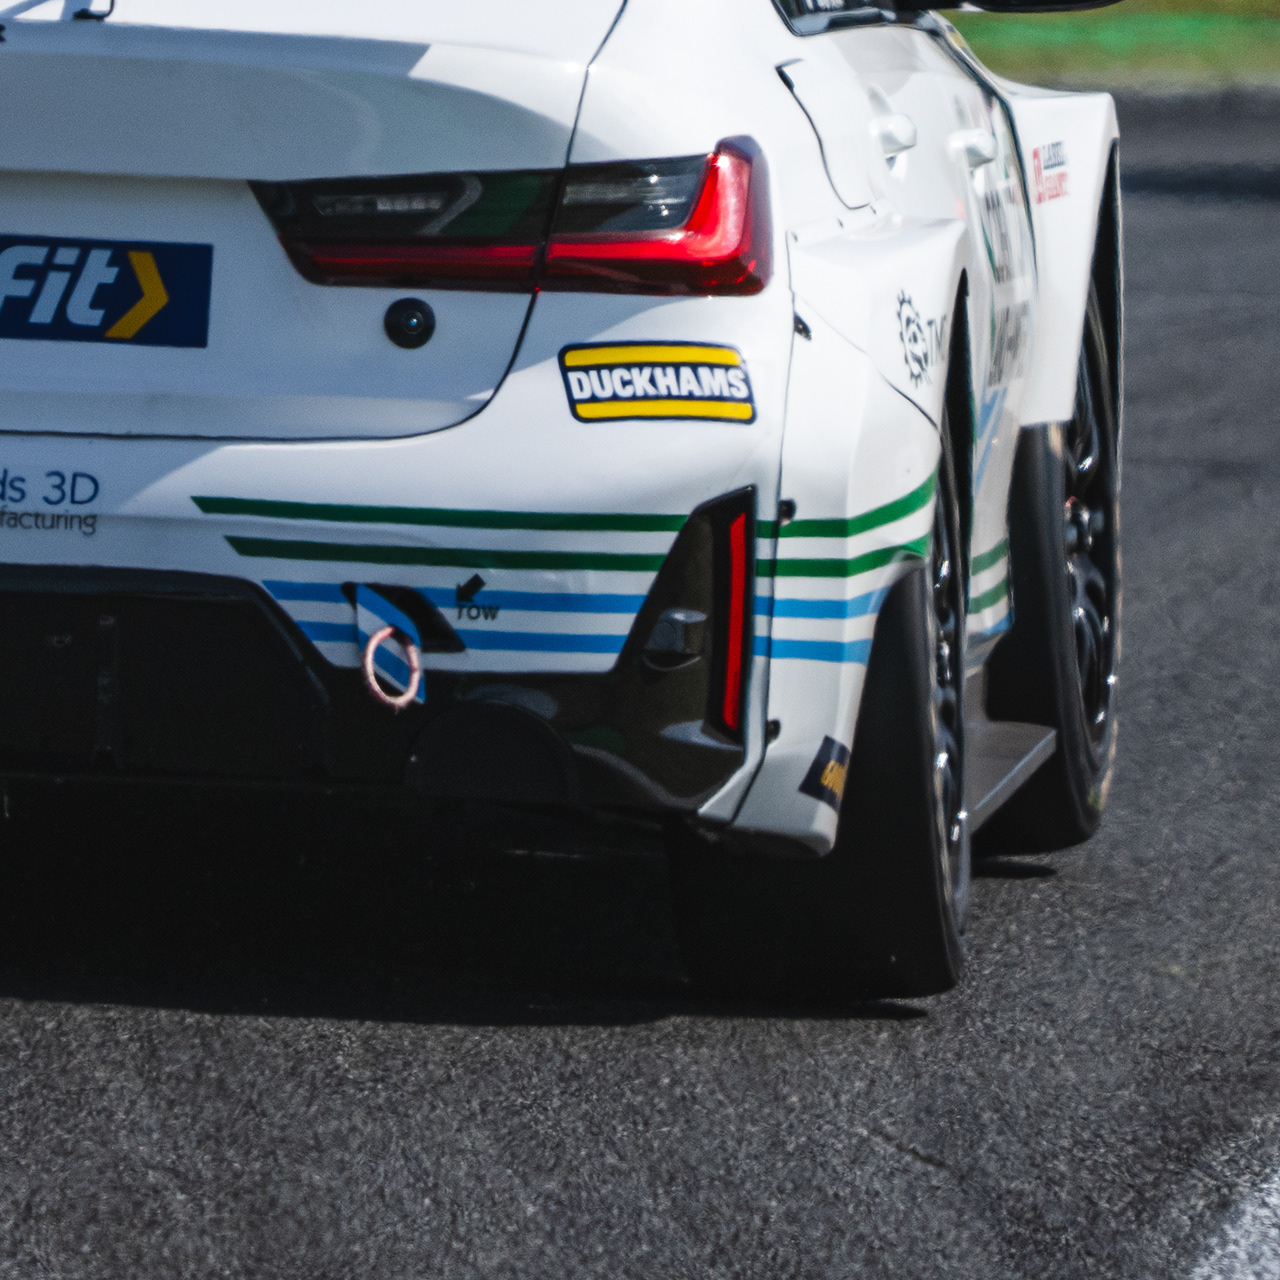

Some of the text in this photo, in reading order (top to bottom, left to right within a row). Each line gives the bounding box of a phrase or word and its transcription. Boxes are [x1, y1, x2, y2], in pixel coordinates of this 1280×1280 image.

[568, 366, 749, 400] DUCKHAMS
[43, 470, 99, 505] 3D
[457, 605, 500, 621] TOW
